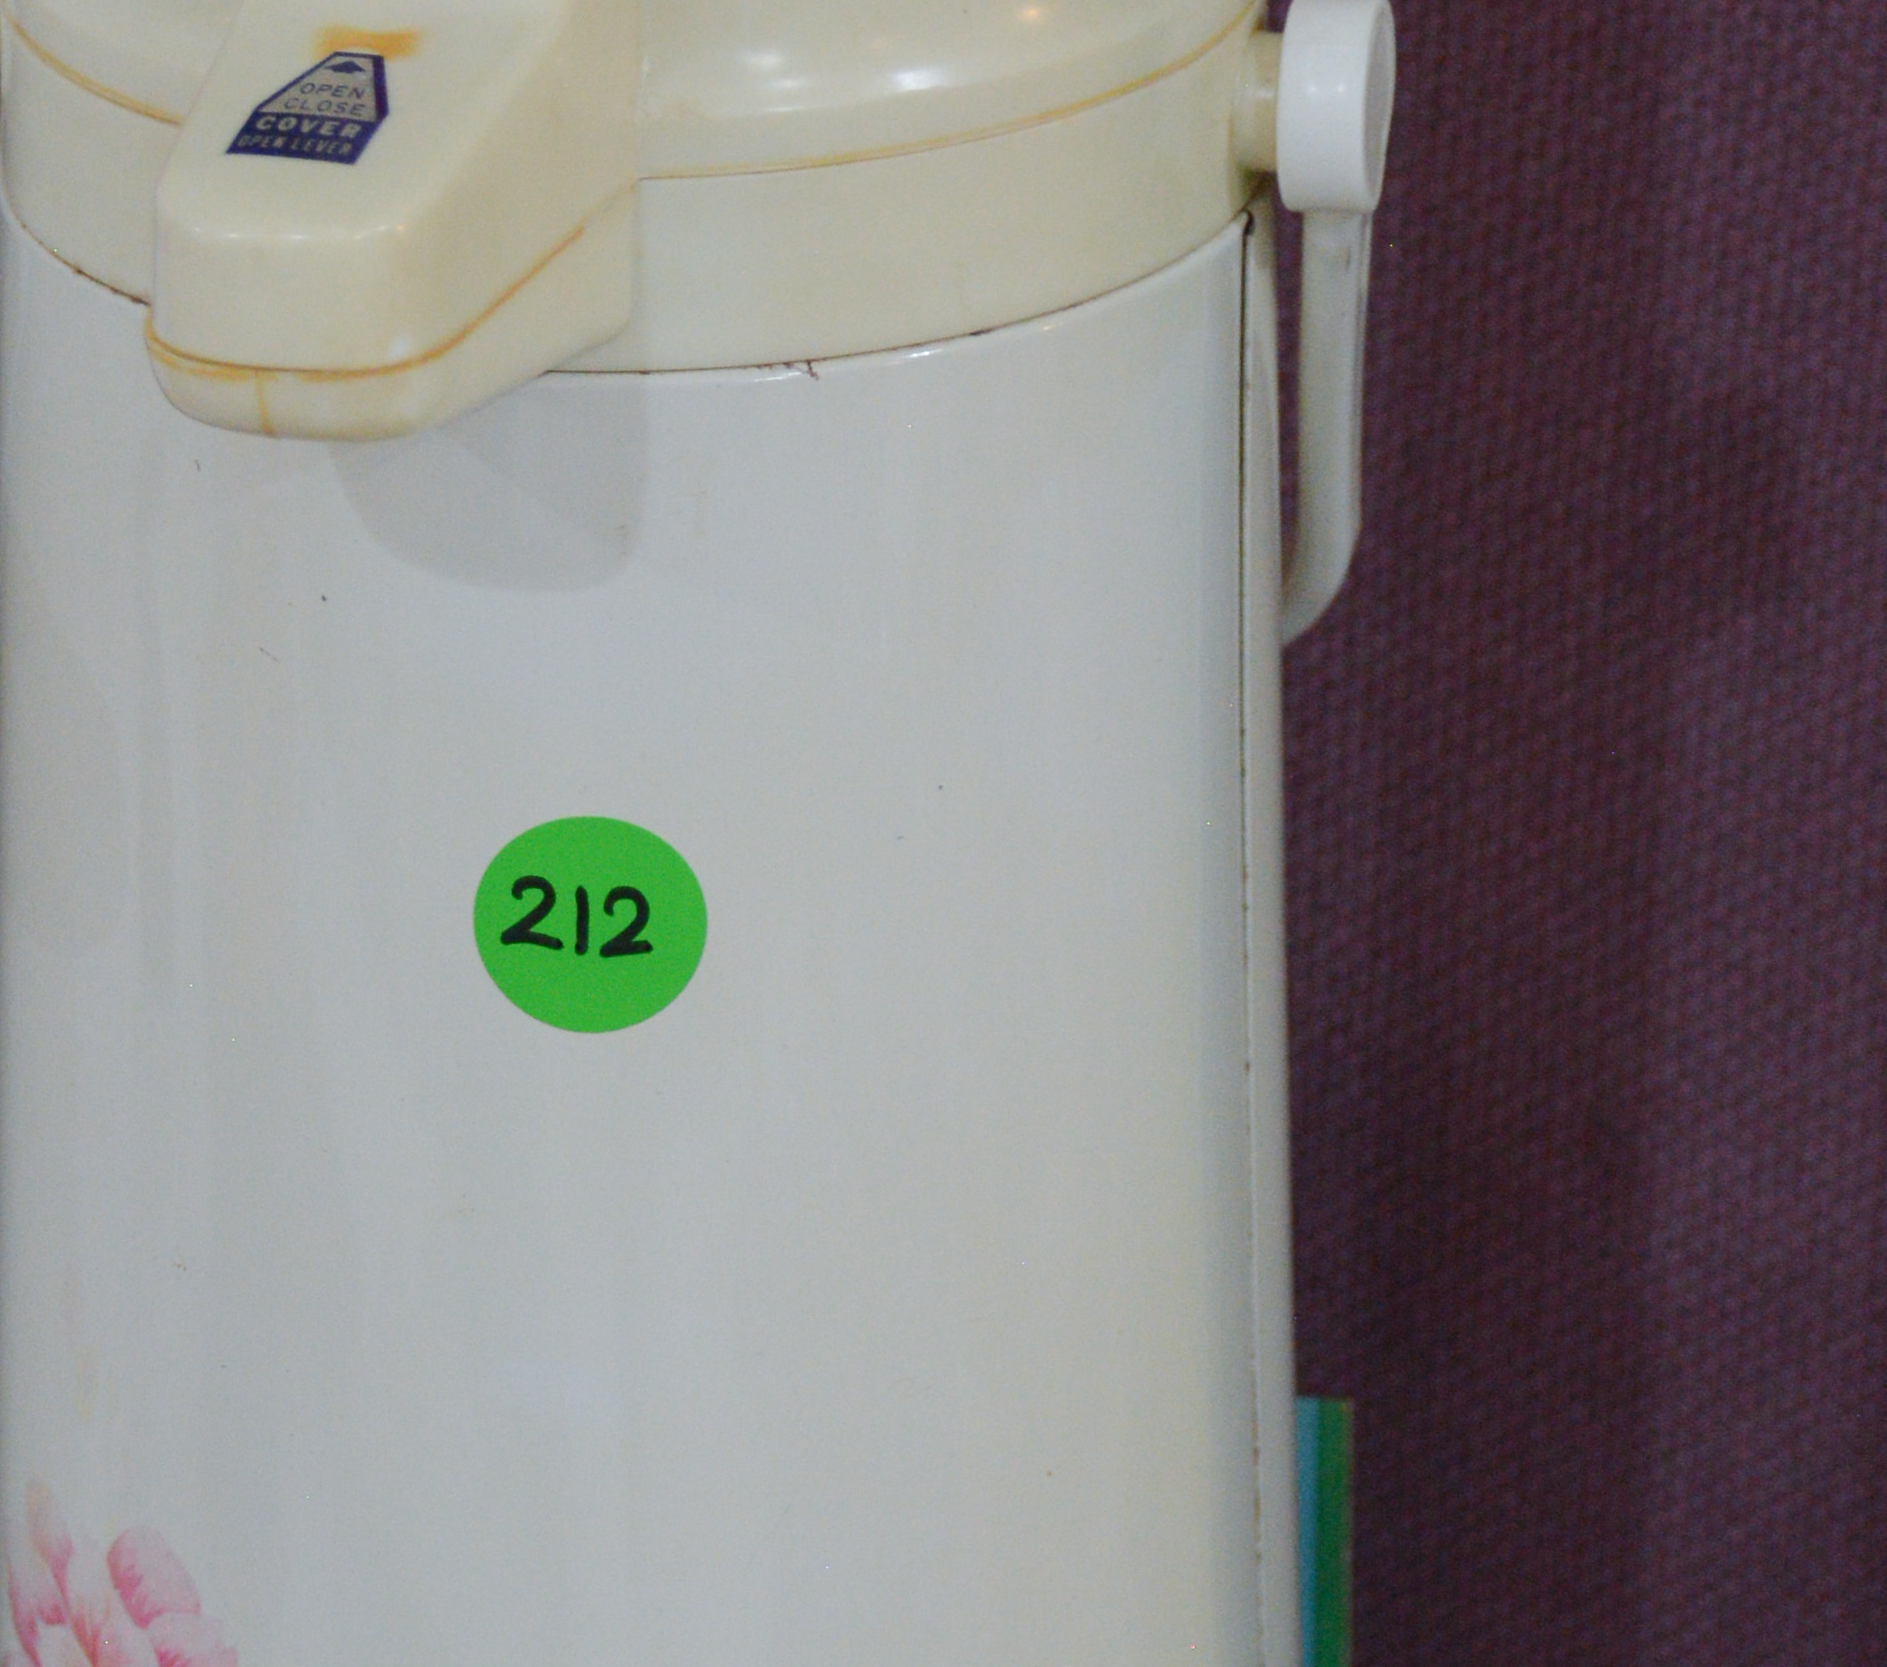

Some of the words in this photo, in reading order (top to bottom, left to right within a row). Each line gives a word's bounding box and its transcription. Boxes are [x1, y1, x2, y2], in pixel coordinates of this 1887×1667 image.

[300, 82, 366, 100] OPEN
[283, 97, 367, 117] CLOSE
[255, 115, 363, 139] COVER
[236, 134, 288, 150] OPEN
[290, 137, 354, 156] LEVER
[499, 874, 654, 959] 212
